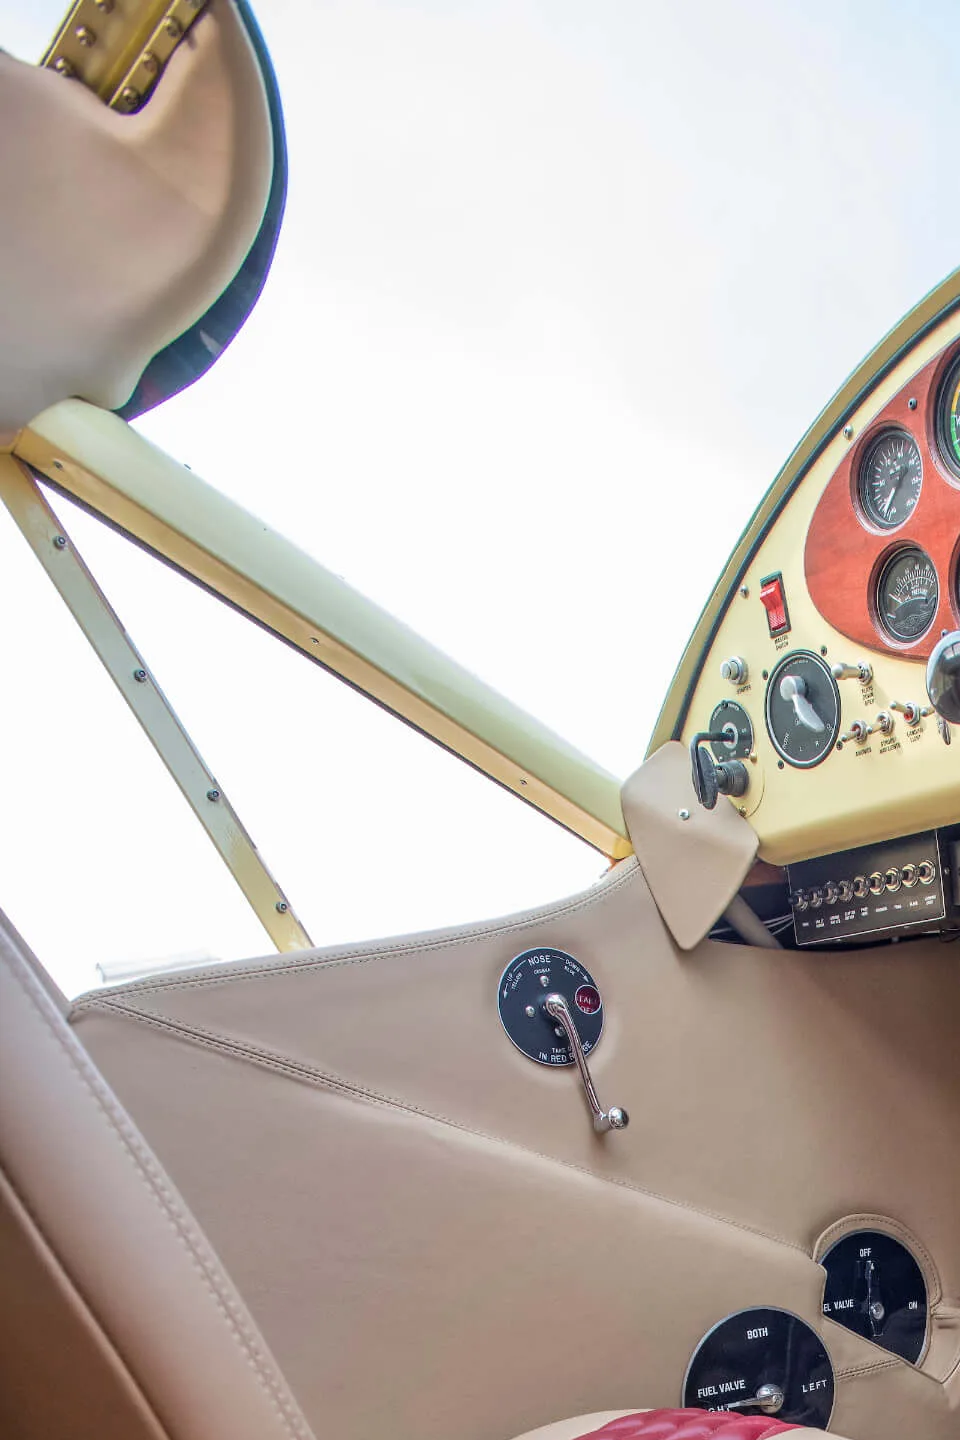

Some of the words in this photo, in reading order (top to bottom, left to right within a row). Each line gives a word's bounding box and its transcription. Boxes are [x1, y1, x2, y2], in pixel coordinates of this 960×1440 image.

[527, 955, 551, 966] NOSE
[565, 959, 580, 972] DOWN
[506, 972, 514, 982] UP
[539, 1052, 548, 1060] IN
[550, 1054, 567, 1063] RED
[860, 1248, 872, 1257] OFF
[823, 1303, 831, 1312] EL
[834, 1299, 854, 1310] VALVE
[908, 1301, 918, 1310] ON
[746, 1327, 768, 1340] BOTH
[697, 1385, 718, 1399] FUEL
[719, 1379, 746, 1394] VALVE
[802, 1379, 827, 1393] LEFT
